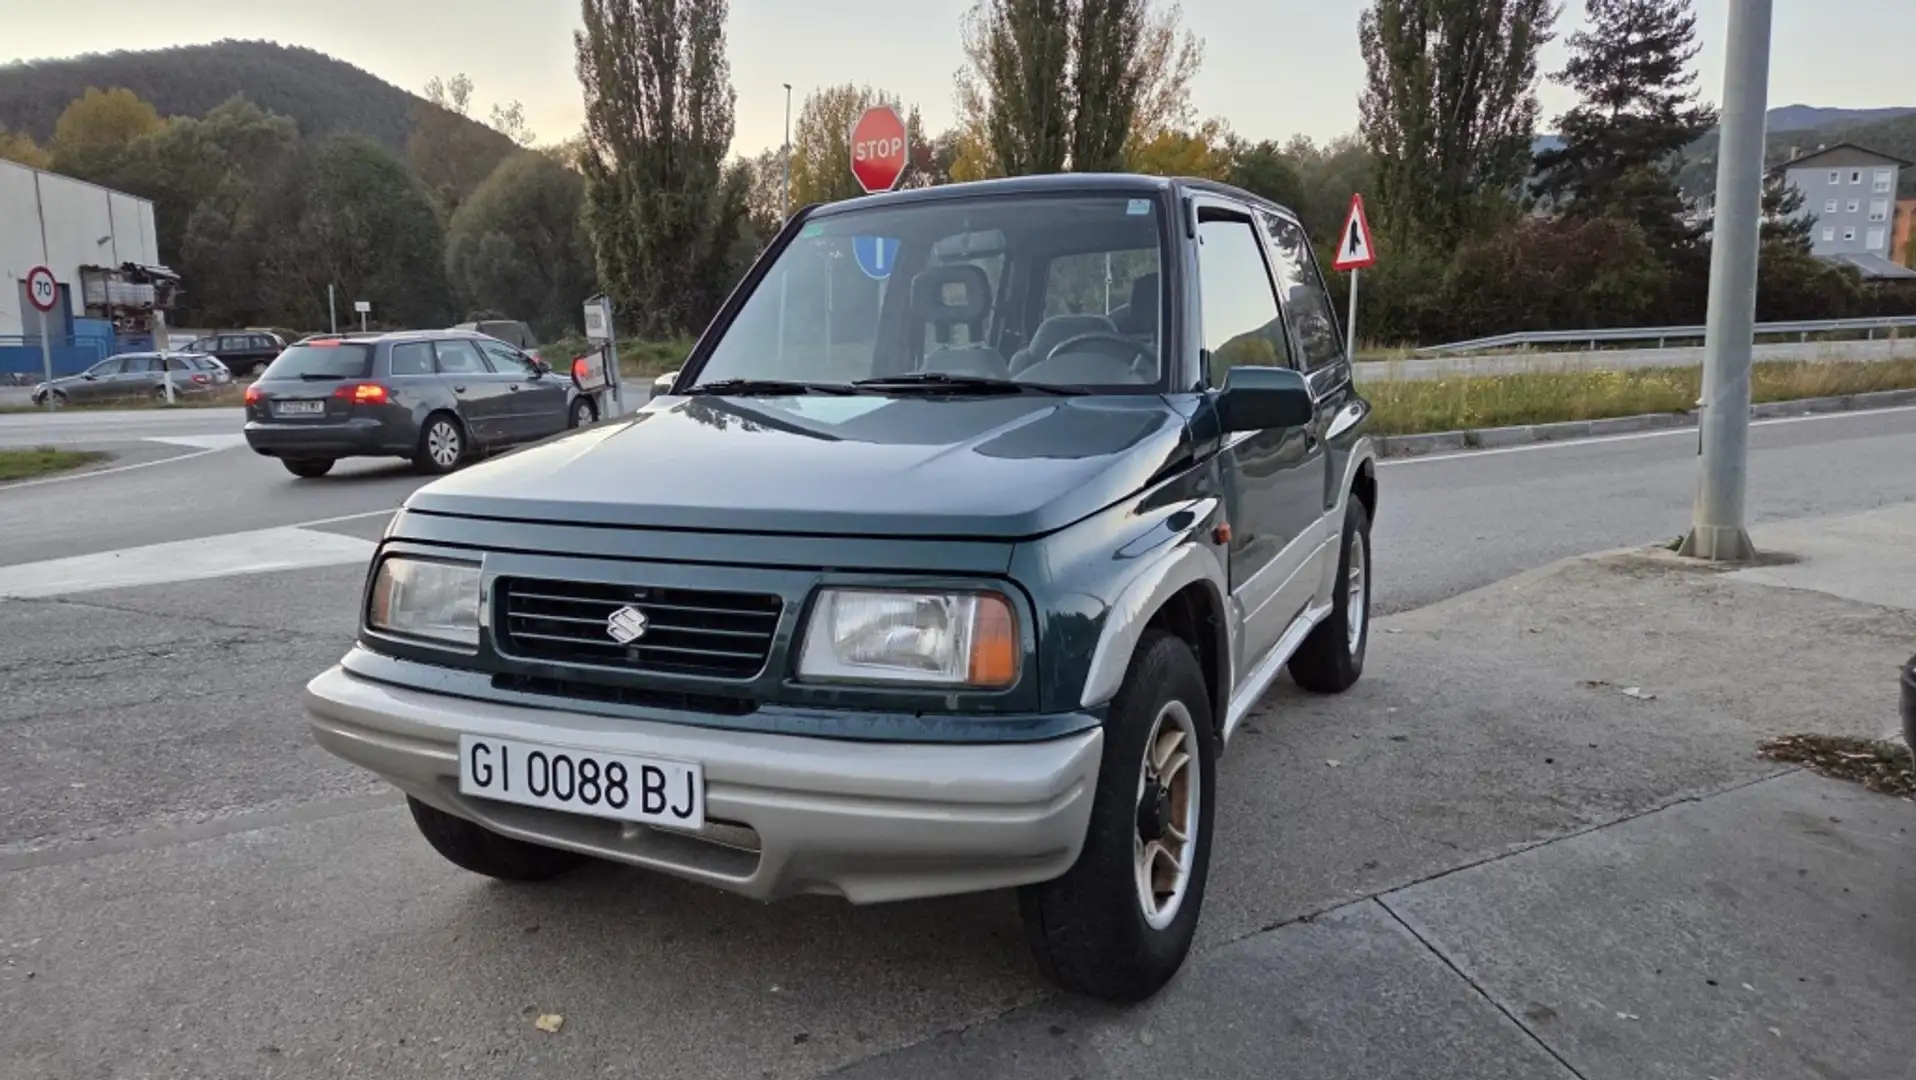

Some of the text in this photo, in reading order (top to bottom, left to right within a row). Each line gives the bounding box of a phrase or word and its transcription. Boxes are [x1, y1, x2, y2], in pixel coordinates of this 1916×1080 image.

[856, 137, 902, 161] STOP
[35, 280, 52, 297] 70
[471, 742, 694, 819] GI 0088 BJ
